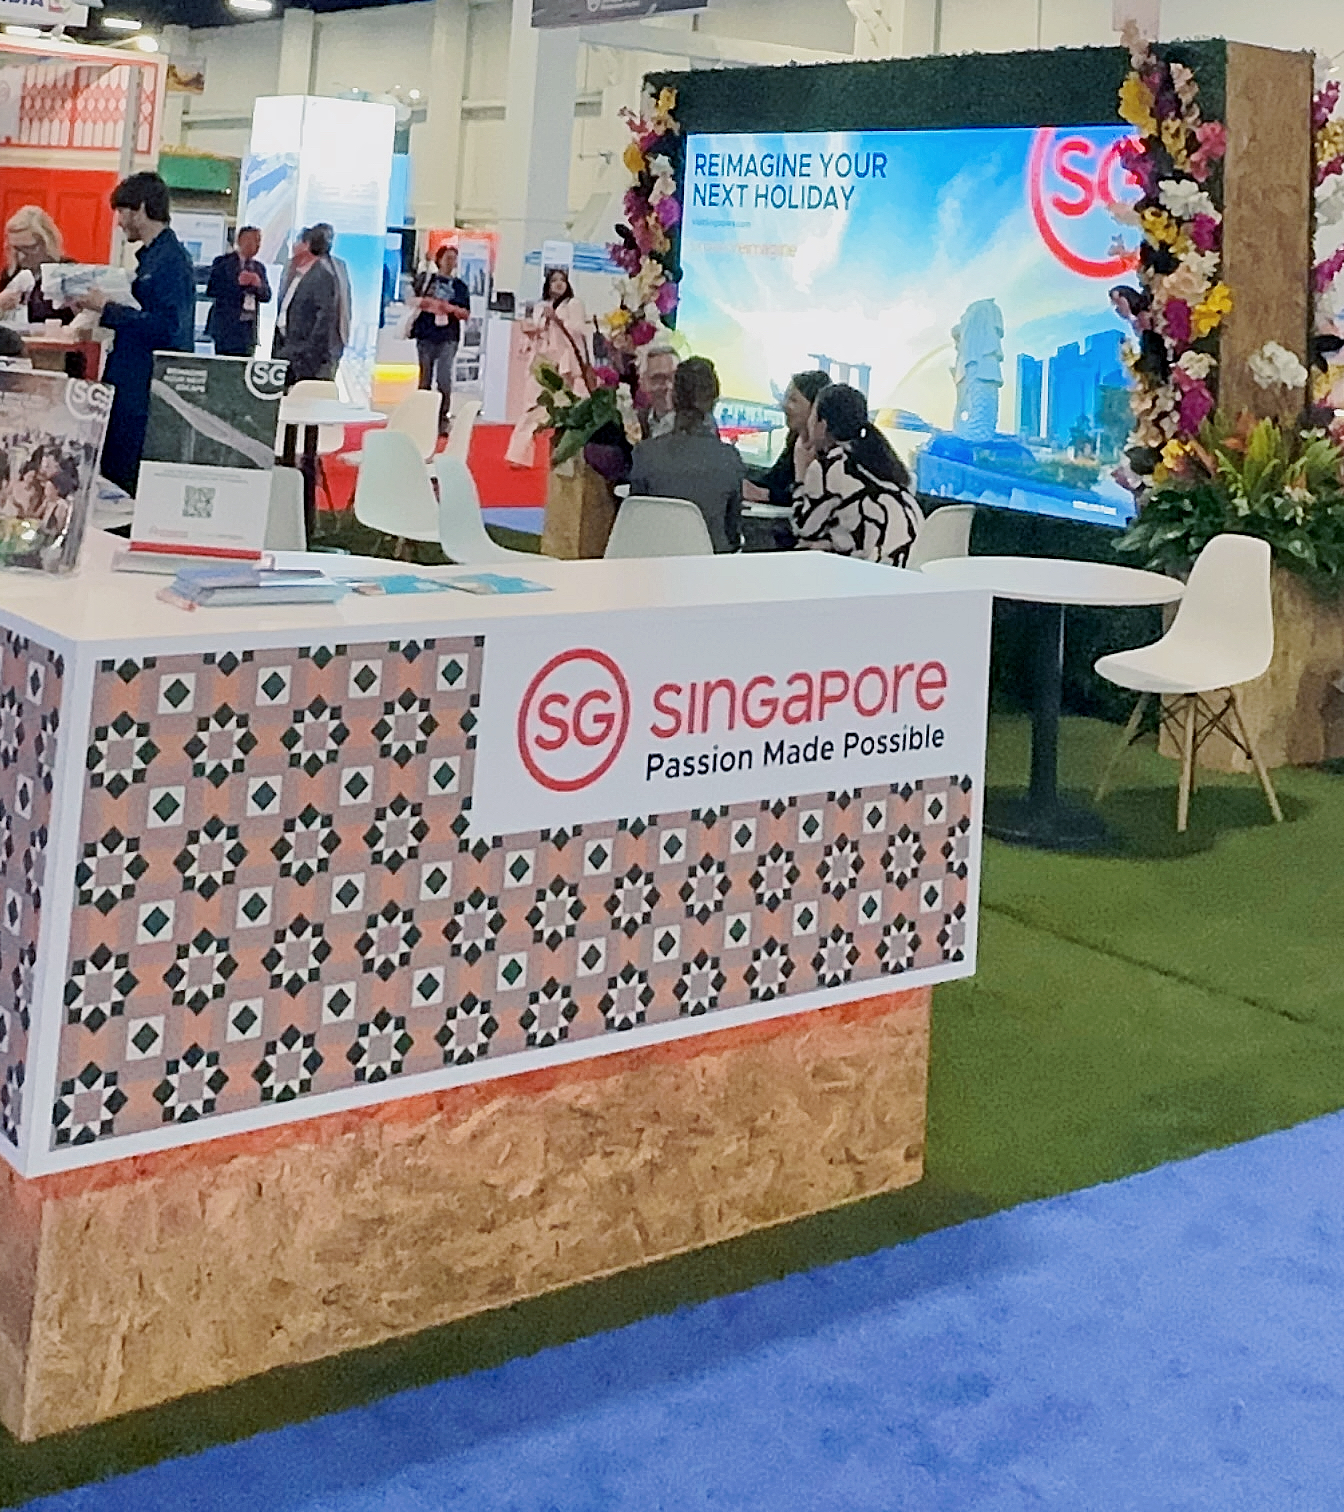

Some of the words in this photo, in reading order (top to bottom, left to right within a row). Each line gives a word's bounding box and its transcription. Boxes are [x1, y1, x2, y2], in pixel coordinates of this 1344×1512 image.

[693, 152, 812, 178] REIMAGINE
[819, 151, 889, 179] YOUR
[692, 182, 749, 208] NEXT
[754, 183, 856, 211] HOLIDAY
[253, 363, 288, 386] SG
[534, 689, 616, 751] SG
[645, 744, 752, 782] Passion
[762, 735, 835, 767] Made
[843, 724, 945, 759] Possible
